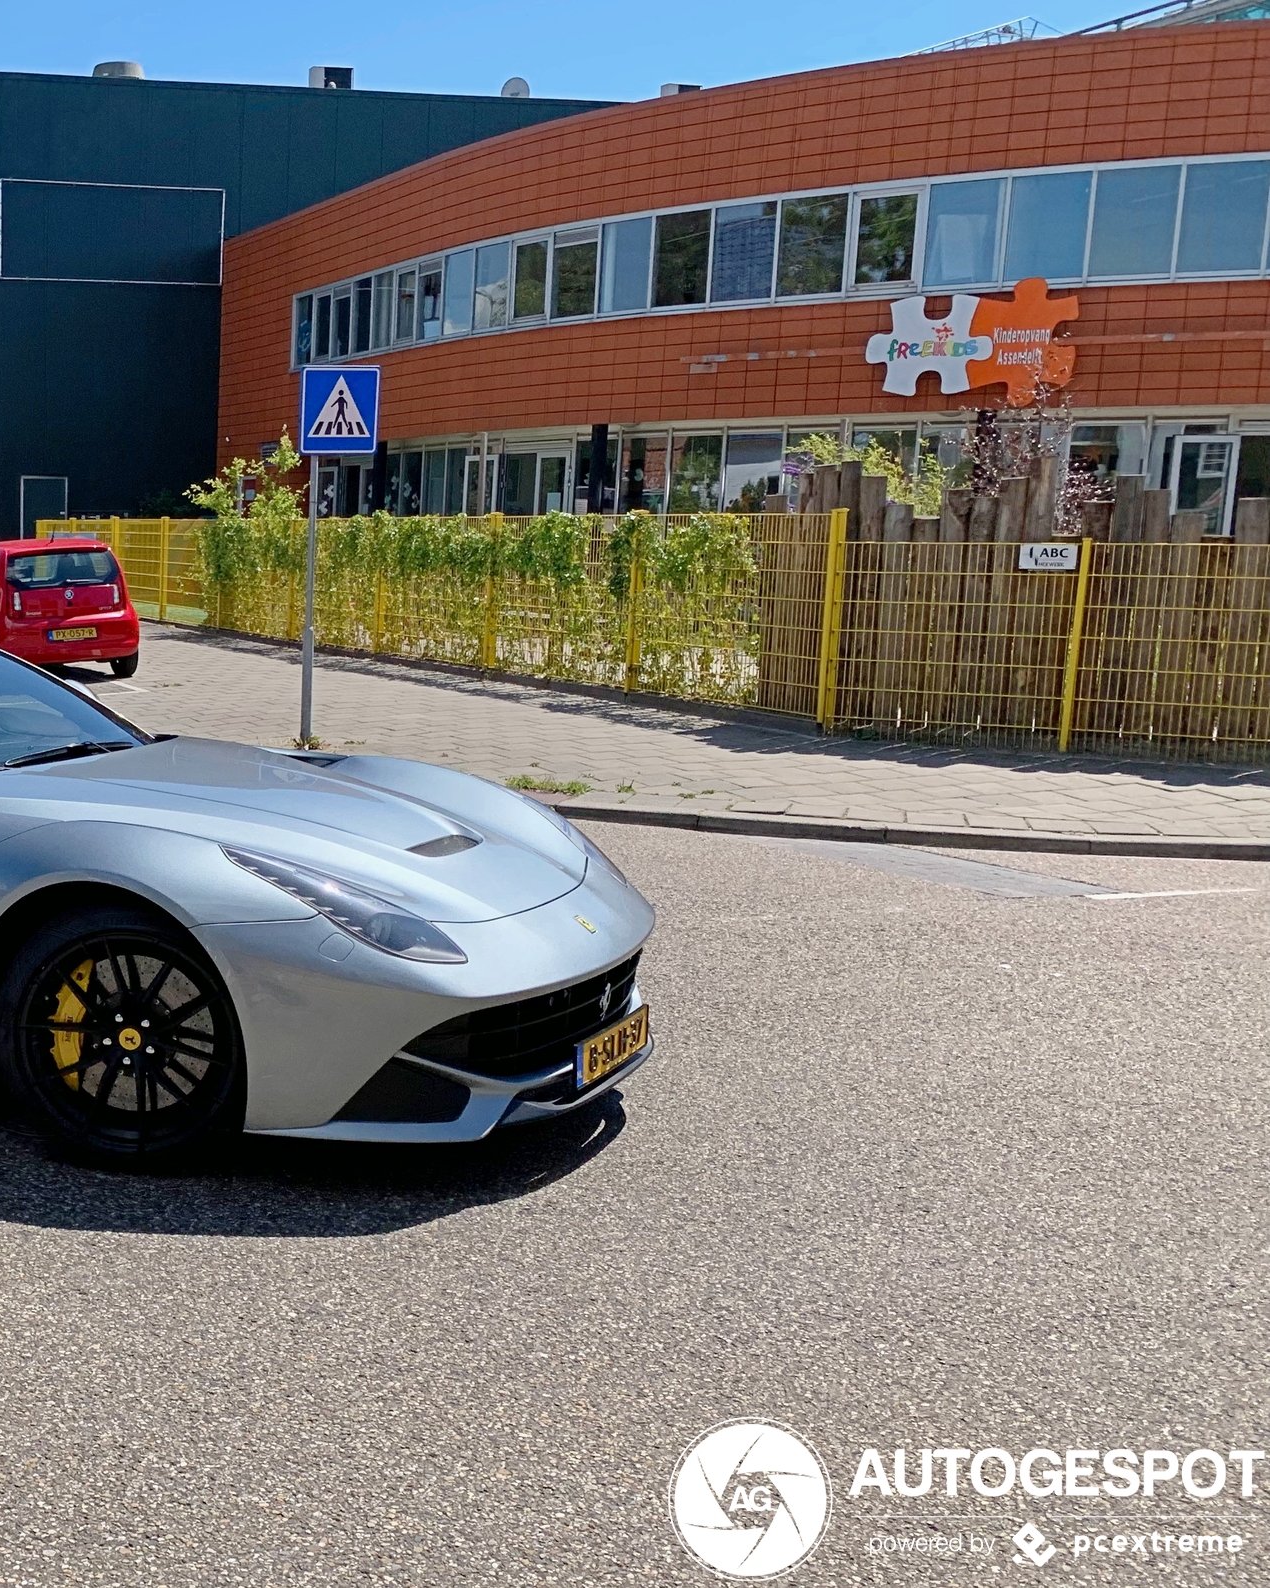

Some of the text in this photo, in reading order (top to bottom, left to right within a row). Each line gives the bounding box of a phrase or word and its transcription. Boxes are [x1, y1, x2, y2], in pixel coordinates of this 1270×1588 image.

[993, 327, 1051, 345] Kinderopvang
[1039, 547, 1069, 558] ABC
[55, 628, 95, 640] PX-057-R
